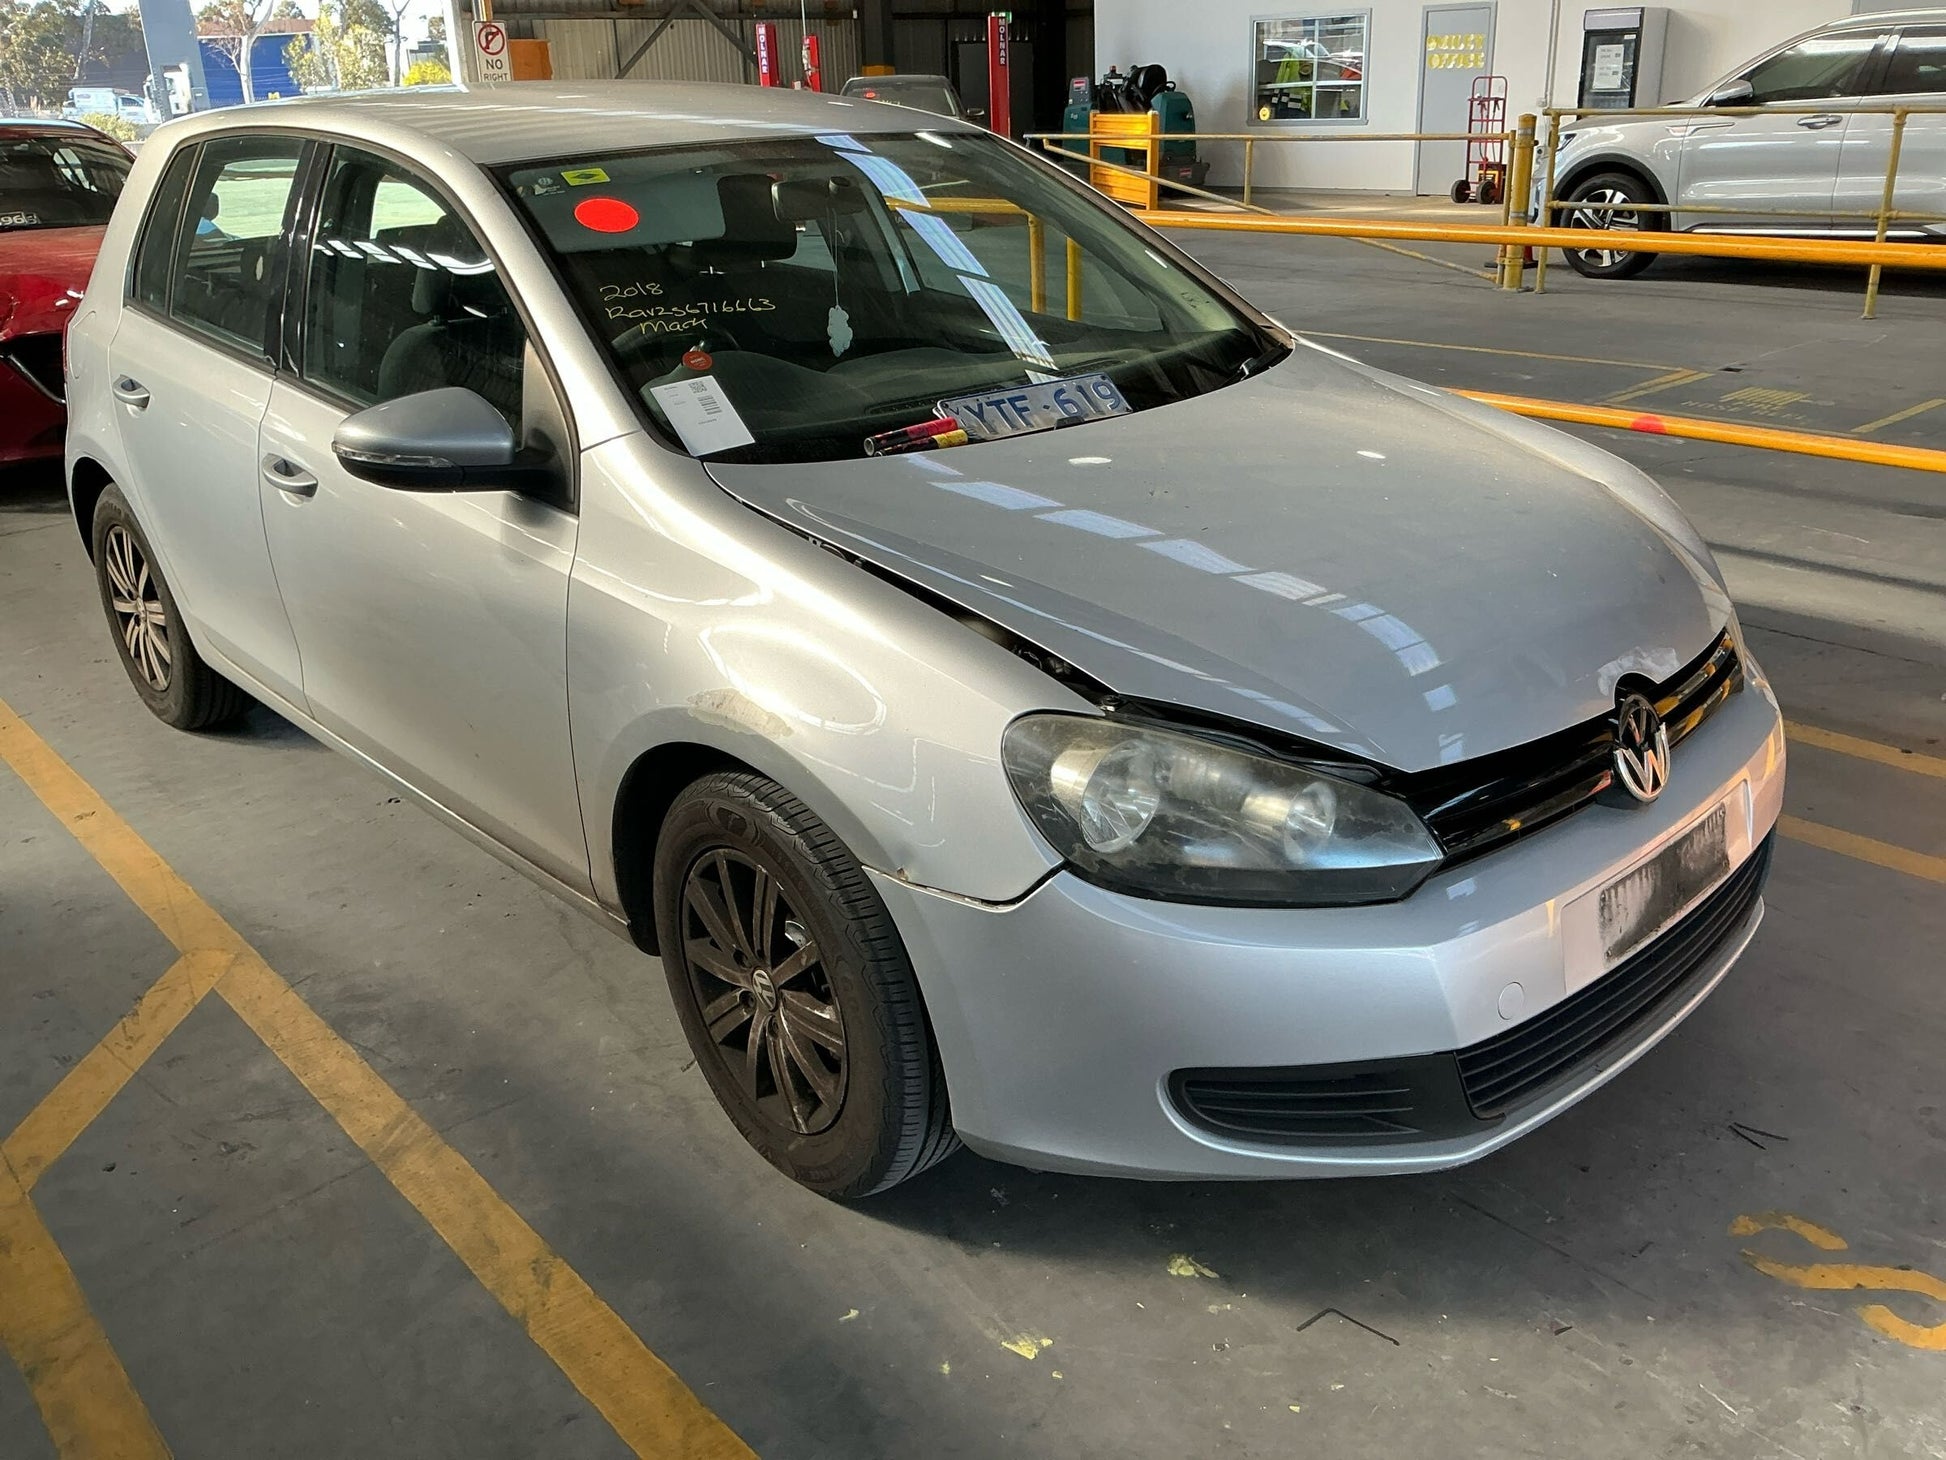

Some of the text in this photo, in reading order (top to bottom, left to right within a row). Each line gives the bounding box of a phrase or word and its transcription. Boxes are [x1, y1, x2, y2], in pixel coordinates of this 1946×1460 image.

[758, 26, 769, 74] MOLNAR
[998, 18, 1006, 65] MOLNAR
[485, 58, 504, 70] NO
[483, 72, 508, 81] RIGHT
[600, 281, 664, 301] 2018
